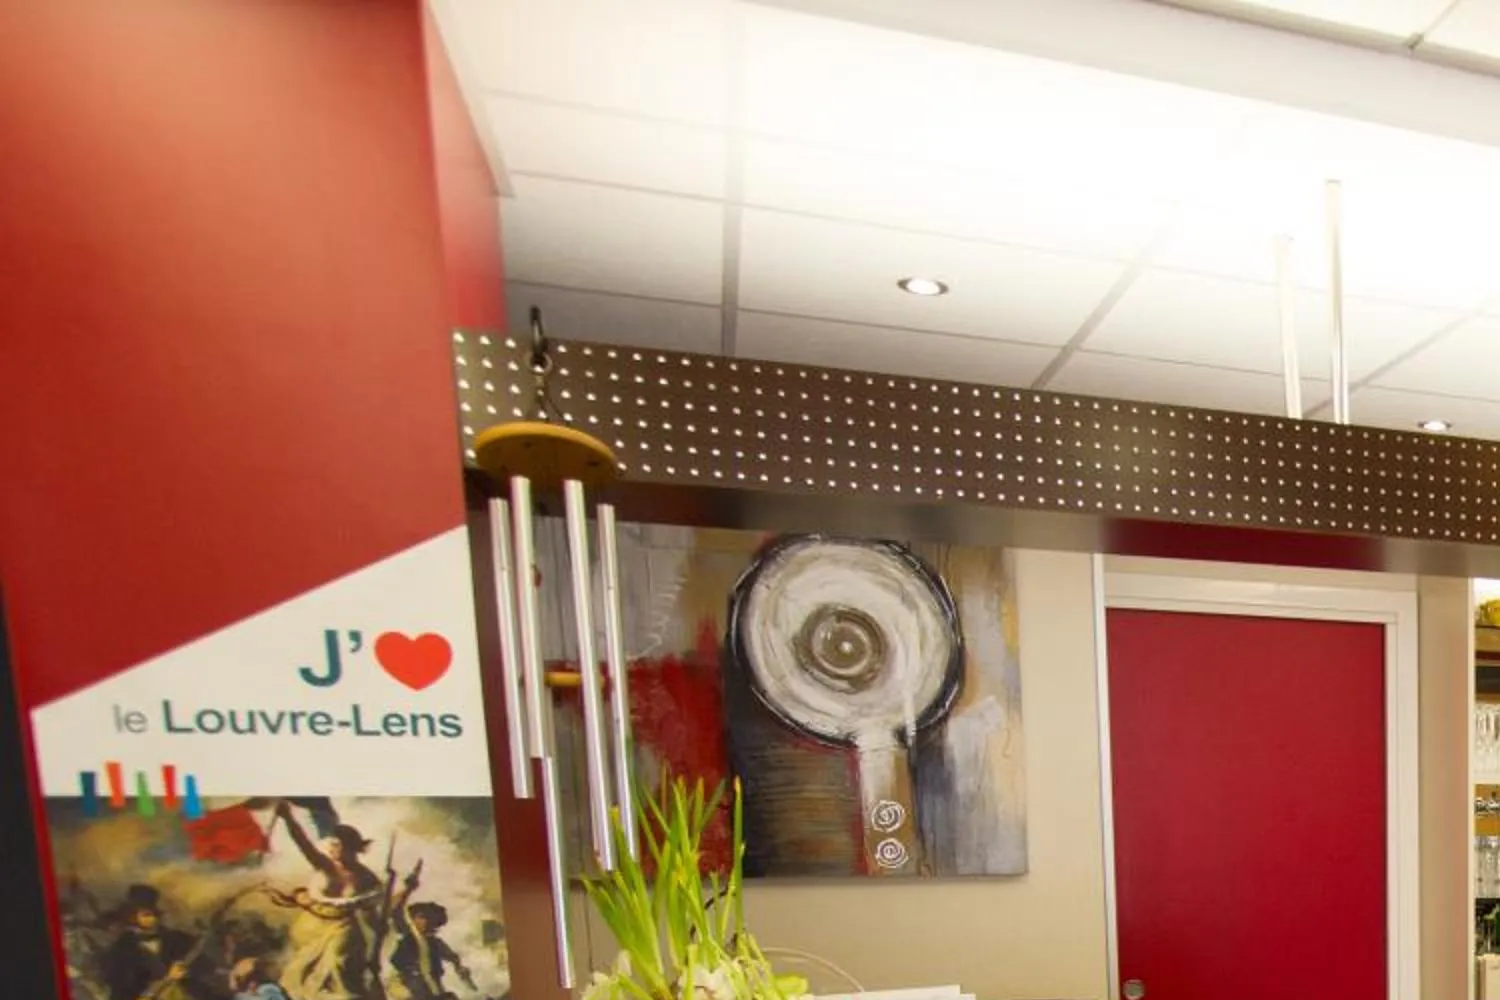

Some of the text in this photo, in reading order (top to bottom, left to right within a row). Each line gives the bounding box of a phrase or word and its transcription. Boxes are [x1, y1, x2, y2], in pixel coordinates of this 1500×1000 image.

[299, 628, 363, 688] J'
[112, 699, 463, 738] le Louvre-Lens
